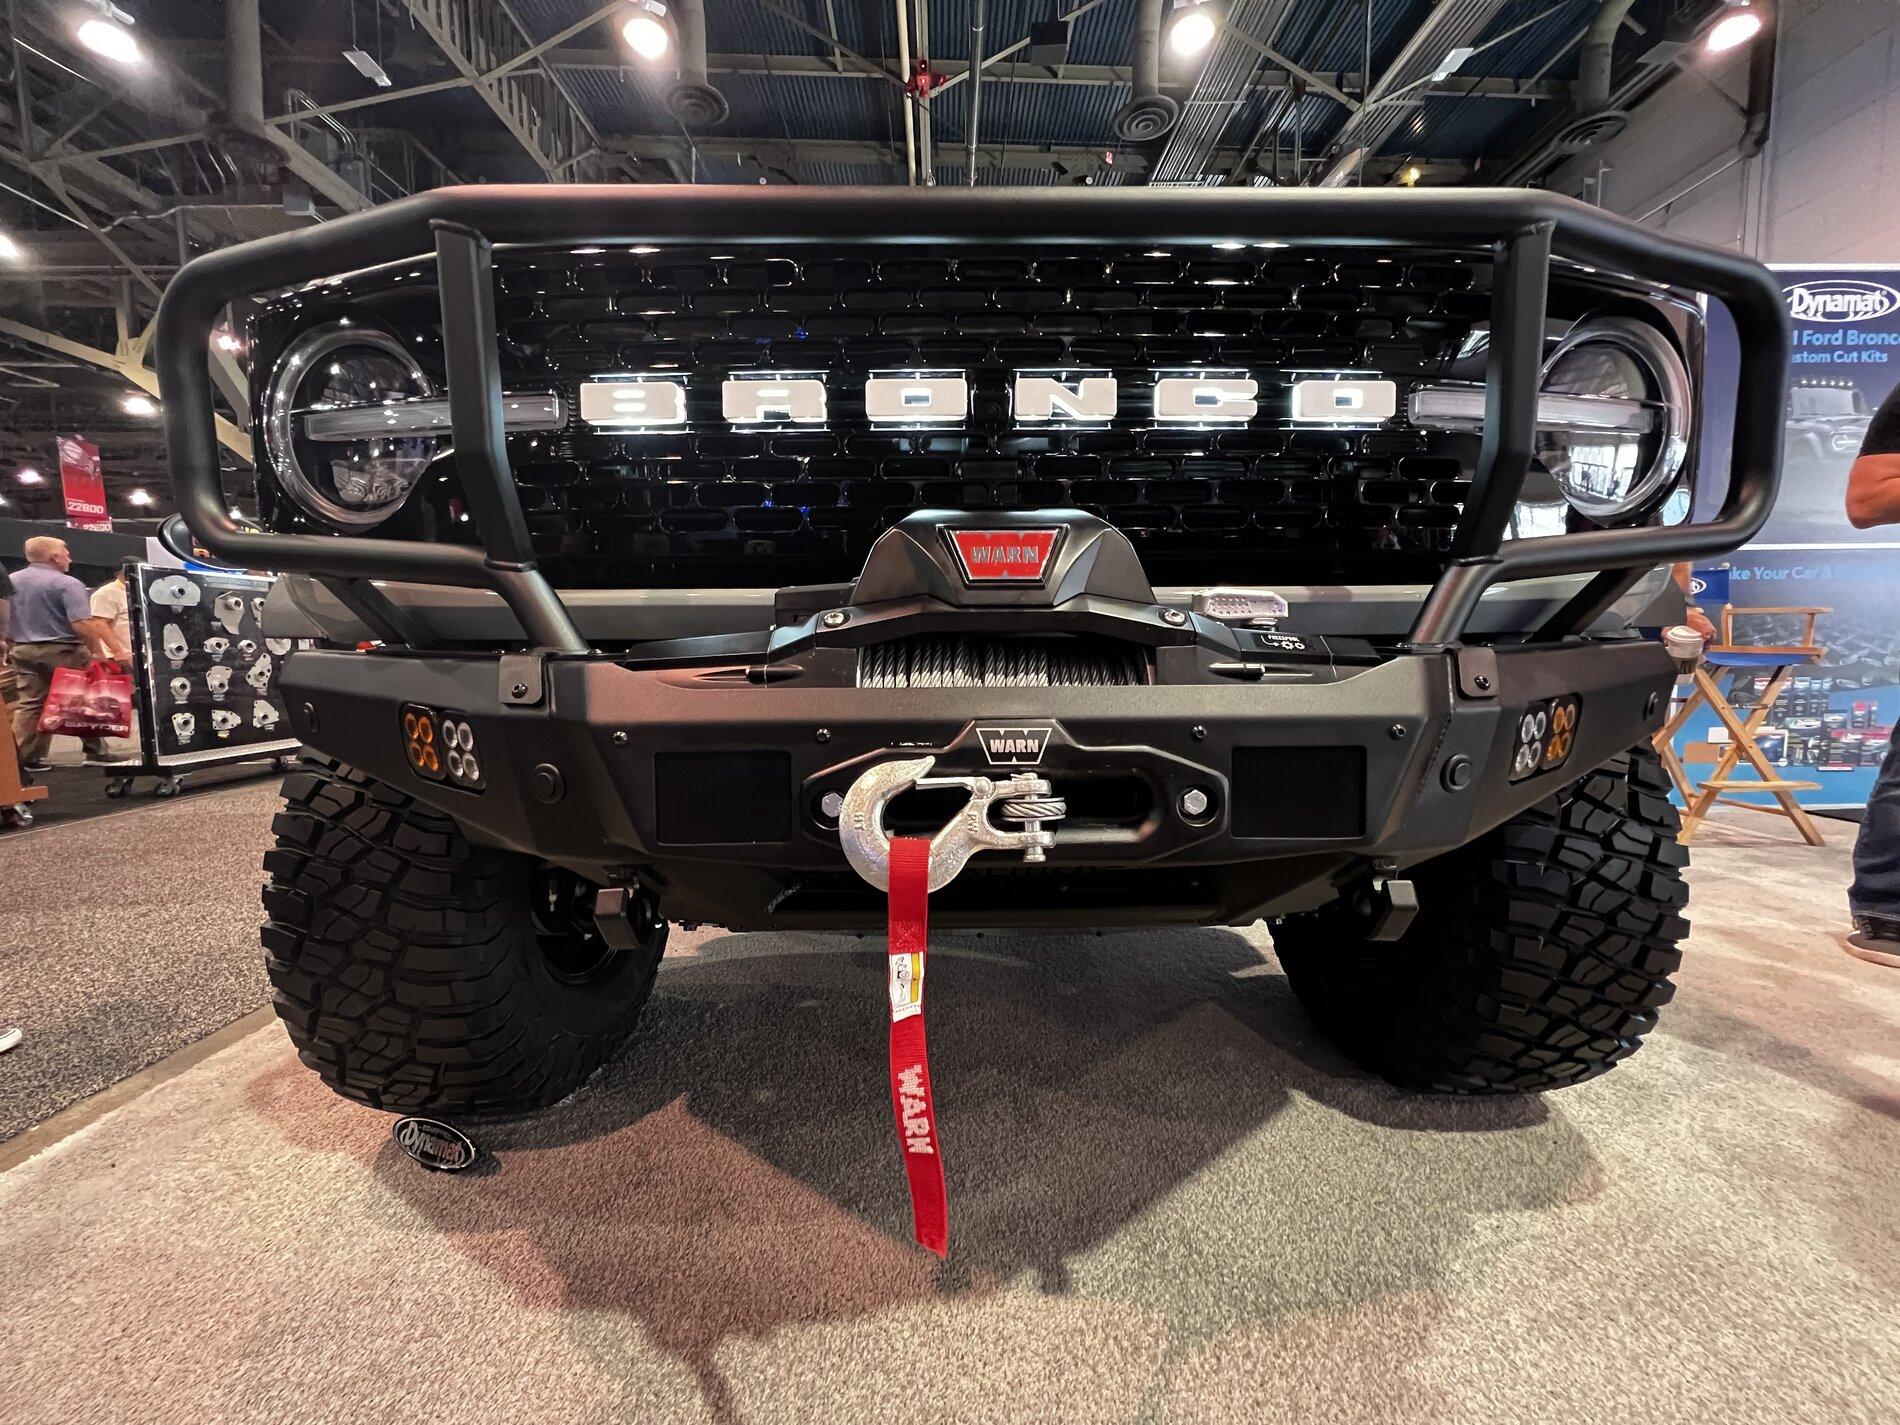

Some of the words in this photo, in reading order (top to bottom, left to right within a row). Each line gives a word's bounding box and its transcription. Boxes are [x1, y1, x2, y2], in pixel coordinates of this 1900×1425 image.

[1791, 288, 1884, 317] Dynamat
[1803, 330, 1843, 345] Ford
[1793, 351, 1831, 362] stom
[1833, 351, 1858, 362] Cut
[1861, 350, 1887, 362] Kits
[580, 378, 1396, 425] BRONCO
[68, 502, 104, 514] 22800
[971, 546, 1039, 564] WARN
[1754, 566, 1790, 580] Your
[1791, 566, 1816, 580] Car
[990, 739, 1039, 753] WARN
[897, 1064, 934, 1154] WARN
[400, 1121, 466, 1163] Dynamat
